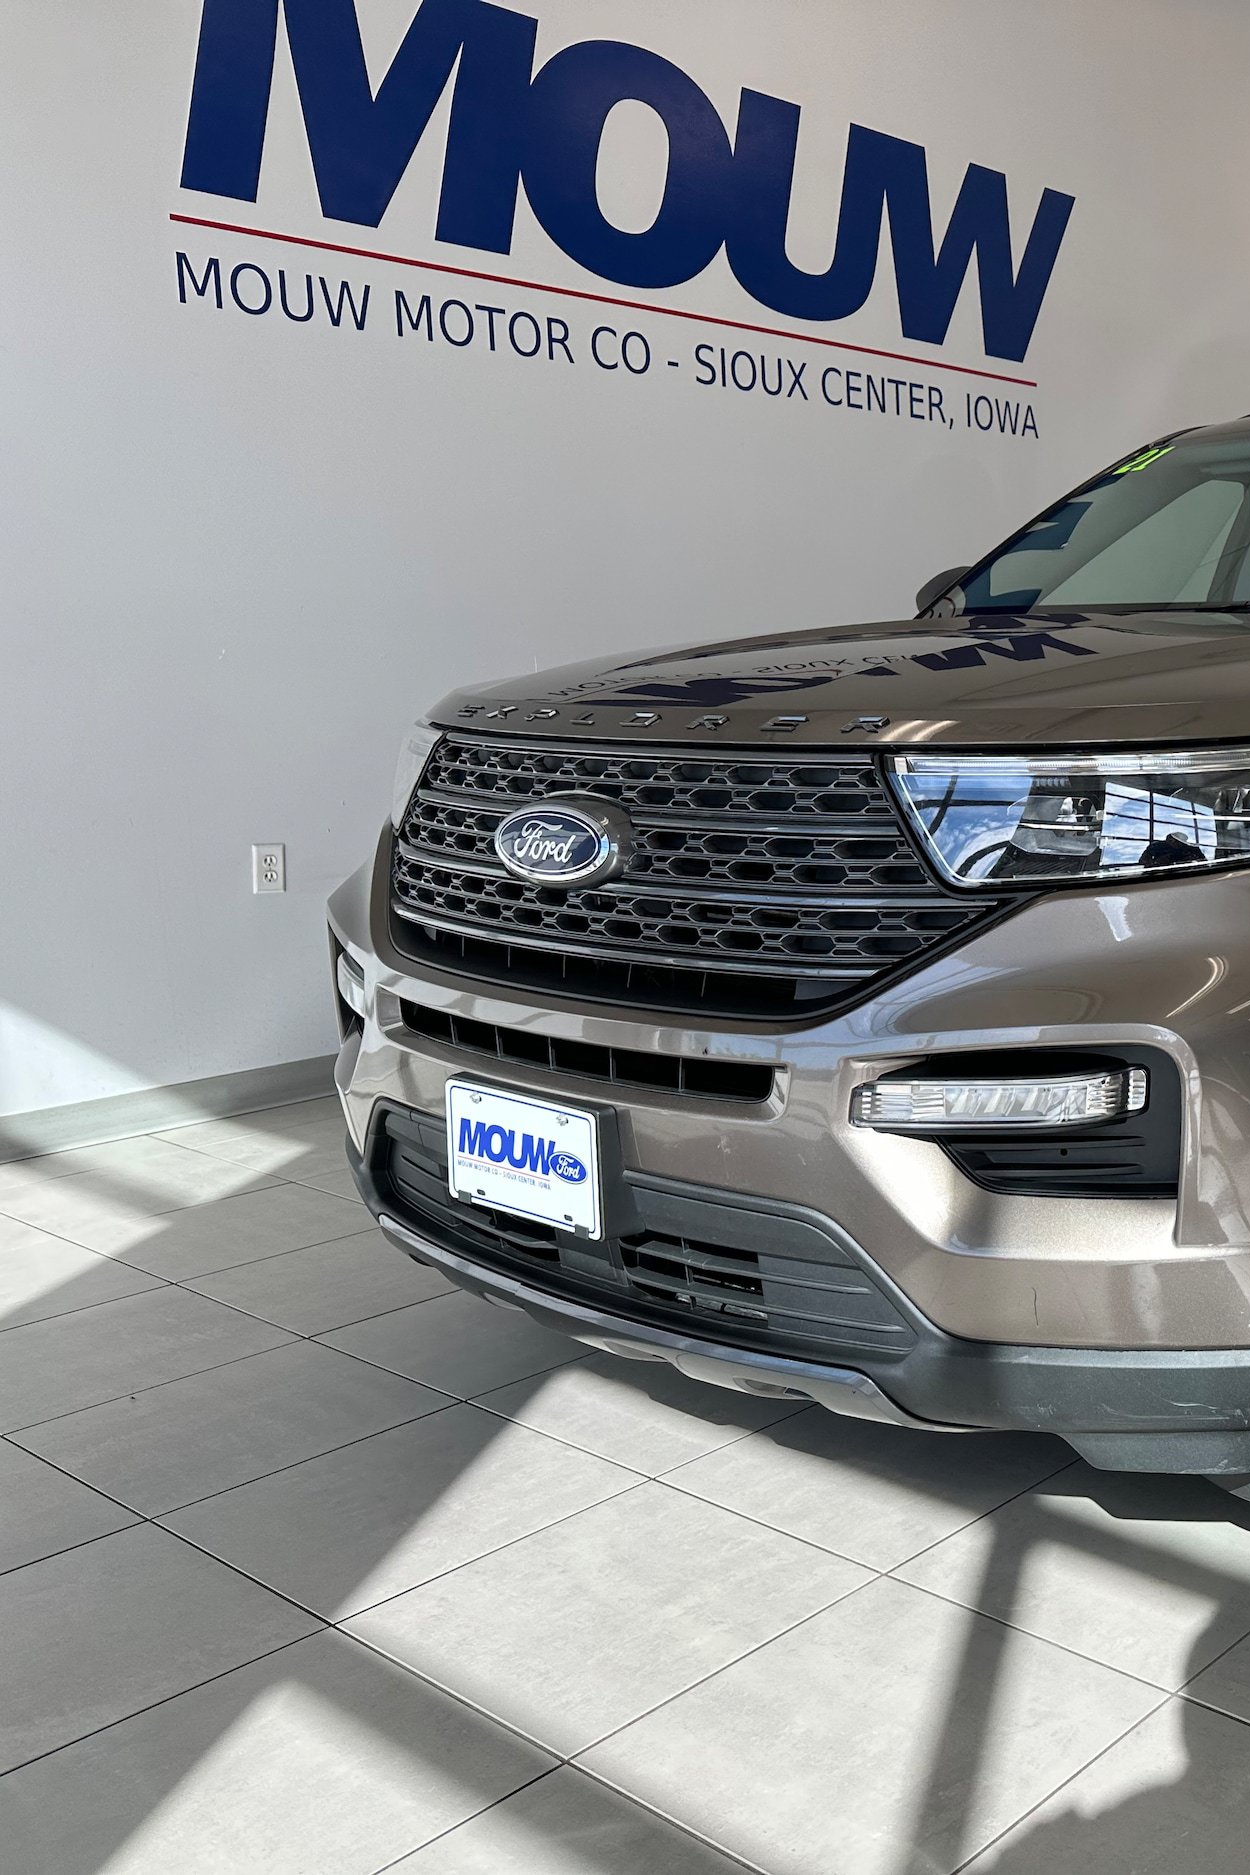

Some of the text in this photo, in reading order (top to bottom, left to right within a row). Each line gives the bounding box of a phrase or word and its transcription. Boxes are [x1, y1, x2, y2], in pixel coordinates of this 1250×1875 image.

[180, 0, 1076, 363] MOUW
[175, 251, 370, 331] MOUW
[395, 289, 575, 364] MOTOR
[590, 326, 651, 375] CO
[694, 343, 809, 401] SIOUX
[821, 366, 954, 430] CENTER,
[965, 393, 1039, 439] IOWA
[457, 703, 891, 734] EXPLORER
[513, 819, 577, 864] Ford
[458, 1117, 581, 1180] MOUW Ford
